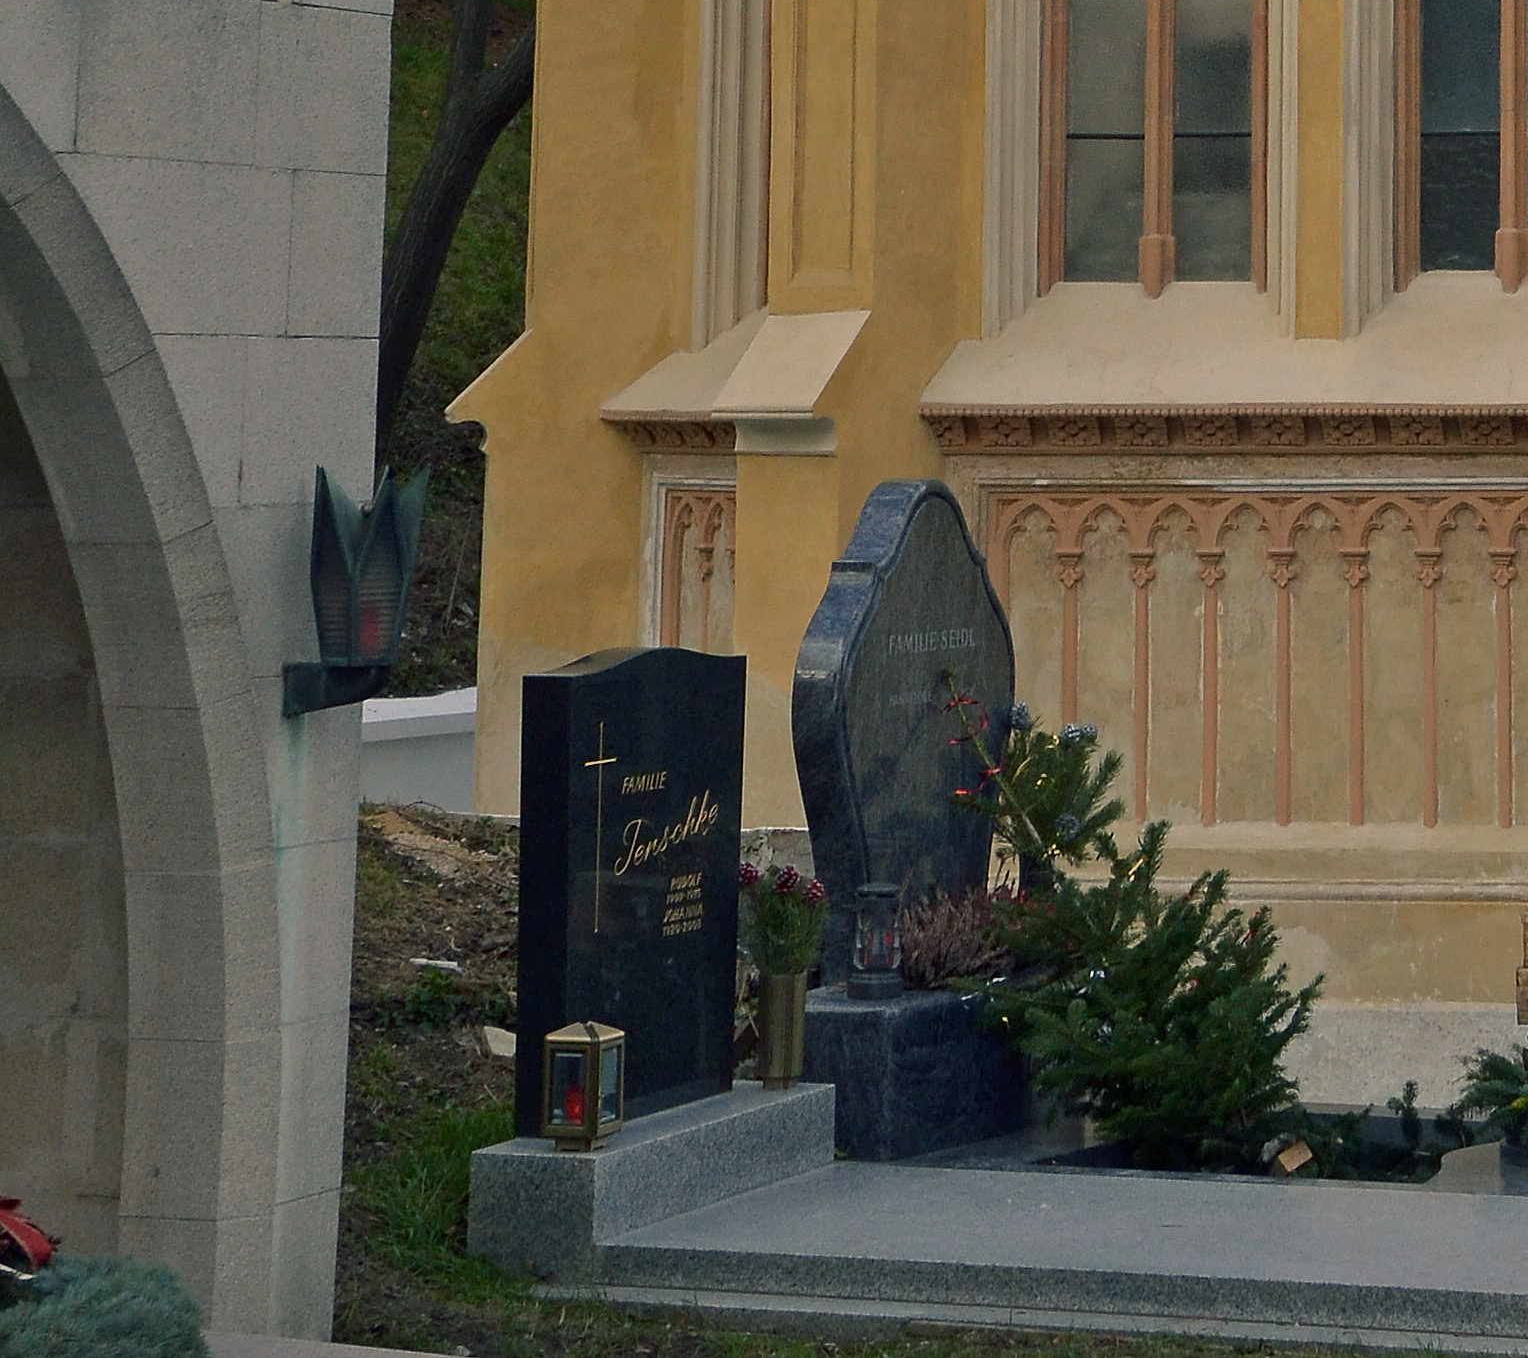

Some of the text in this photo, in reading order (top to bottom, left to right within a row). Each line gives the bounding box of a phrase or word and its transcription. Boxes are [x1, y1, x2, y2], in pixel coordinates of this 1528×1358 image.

[889, 627, 976, 655] FAMILIE SEIDL
[622, 771, 667, 795] FAMILIE
[614, 789, 719, 876] Jenschke
[670, 872, 703, 890] RUDOLF
[663, 904, 703, 923] JOHANNA
